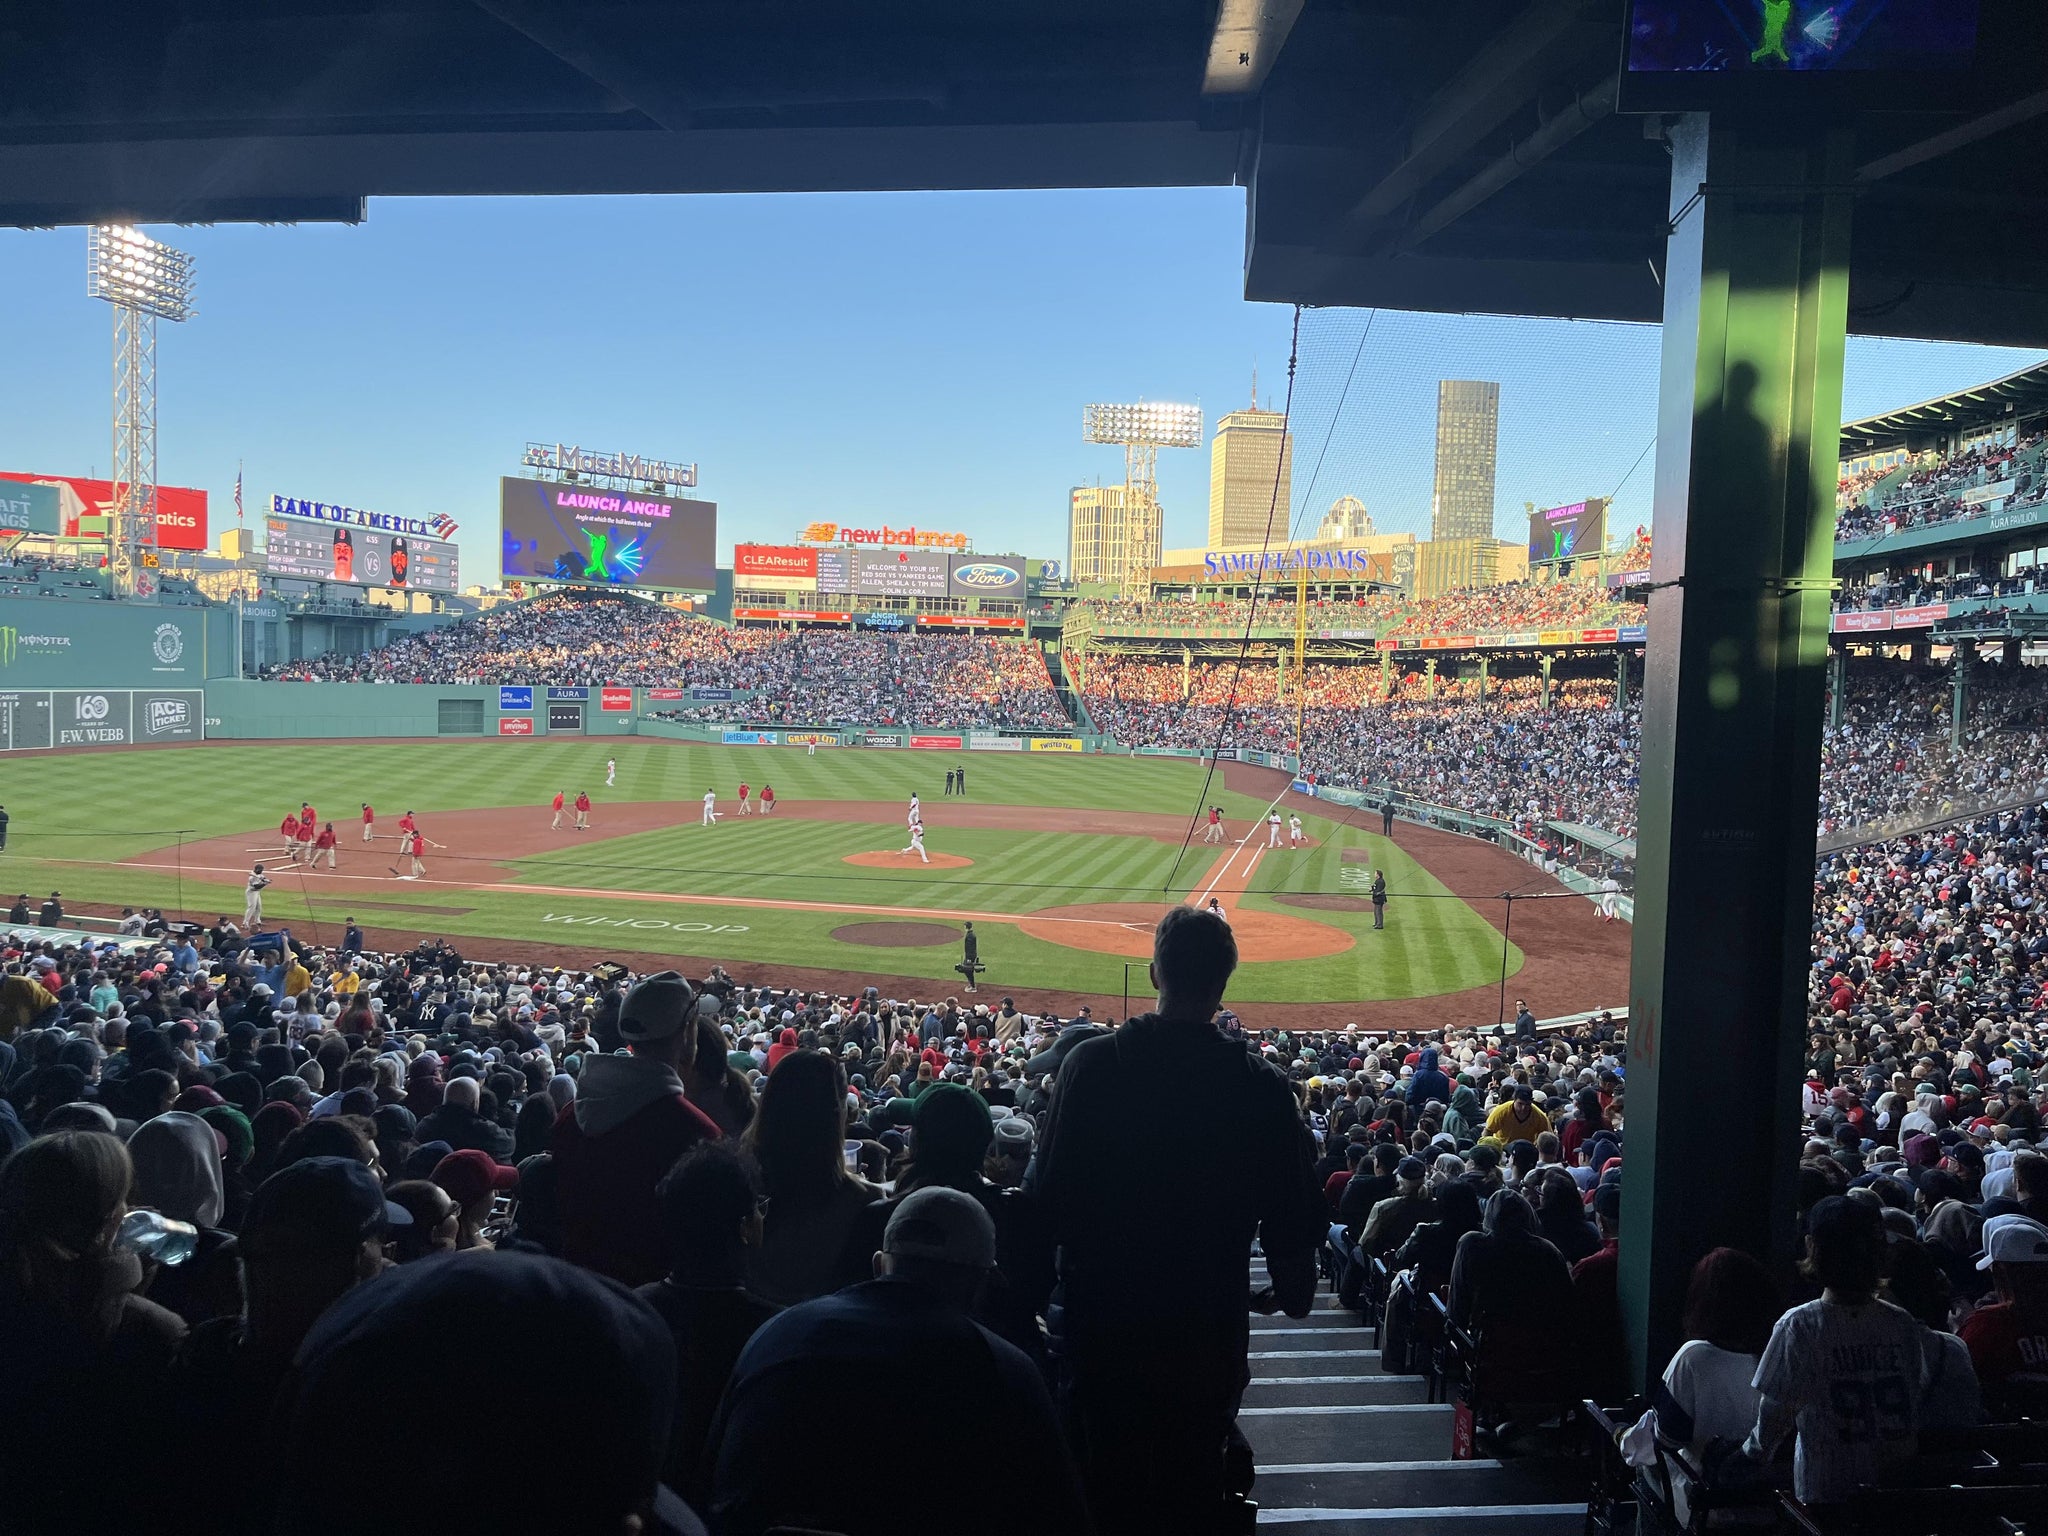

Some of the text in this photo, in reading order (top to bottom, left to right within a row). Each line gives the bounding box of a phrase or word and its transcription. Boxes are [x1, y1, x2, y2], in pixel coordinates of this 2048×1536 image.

[557, 443, 698, 487] MassMutual
[0, 499, 31, 515] AFT
[557, 492, 672, 518] LAUNCH ANGLE
[1545, 503, 1586, 520] LAUNCH ANGLE
[0, 512, 30, 529] NGS
[273, 494, 428, 535] BANK OF AMERICA
[2009, 511, 2038, 526] PAVILION
[840, 528, 881, 543] new
[883, 525, 967, 547] balance
[412, 541, 423, 550] DUE
[366, 557, 379, 572] VS
[743, 555, 809, 567] CLEAResult
[1204, 551, 1290, 577] SAMUEL
[1291, 547, 1368, 572] ADAMS
[966, 566, 1007, 585] Ford
[1625, 572, 1651, 584] UNITED
[242, 606, 278, 618] ABIOMED
[871, 612, 898, 620] ANGRY
[864, 618, 904, 626] ORCHARD
[19, 634, 71, 646] MONSTER
[602, 694, 631, 702] Safelite
[662, 690, 682, 699] TICKET
[75, 695, 109, 720] 160
[154, 701, 187, 717] ACE
[155, 714, 187, 727] TICKET
[204, 717, 221, 726] 379
[60, 728, 125, 744] F.W. WEBB
[726, 732, 754, 744] jetBlue
[821, 734, 838, 744] CITY
[866, 735, 898, 745] wasabi
[1040, 742, 1073, 750] TWISTED TEA
[541, 913, 750, 933] WHOOP
[419, 1004, 437, 1020] NY
[1811, 1090, 1828, 1105] 15
